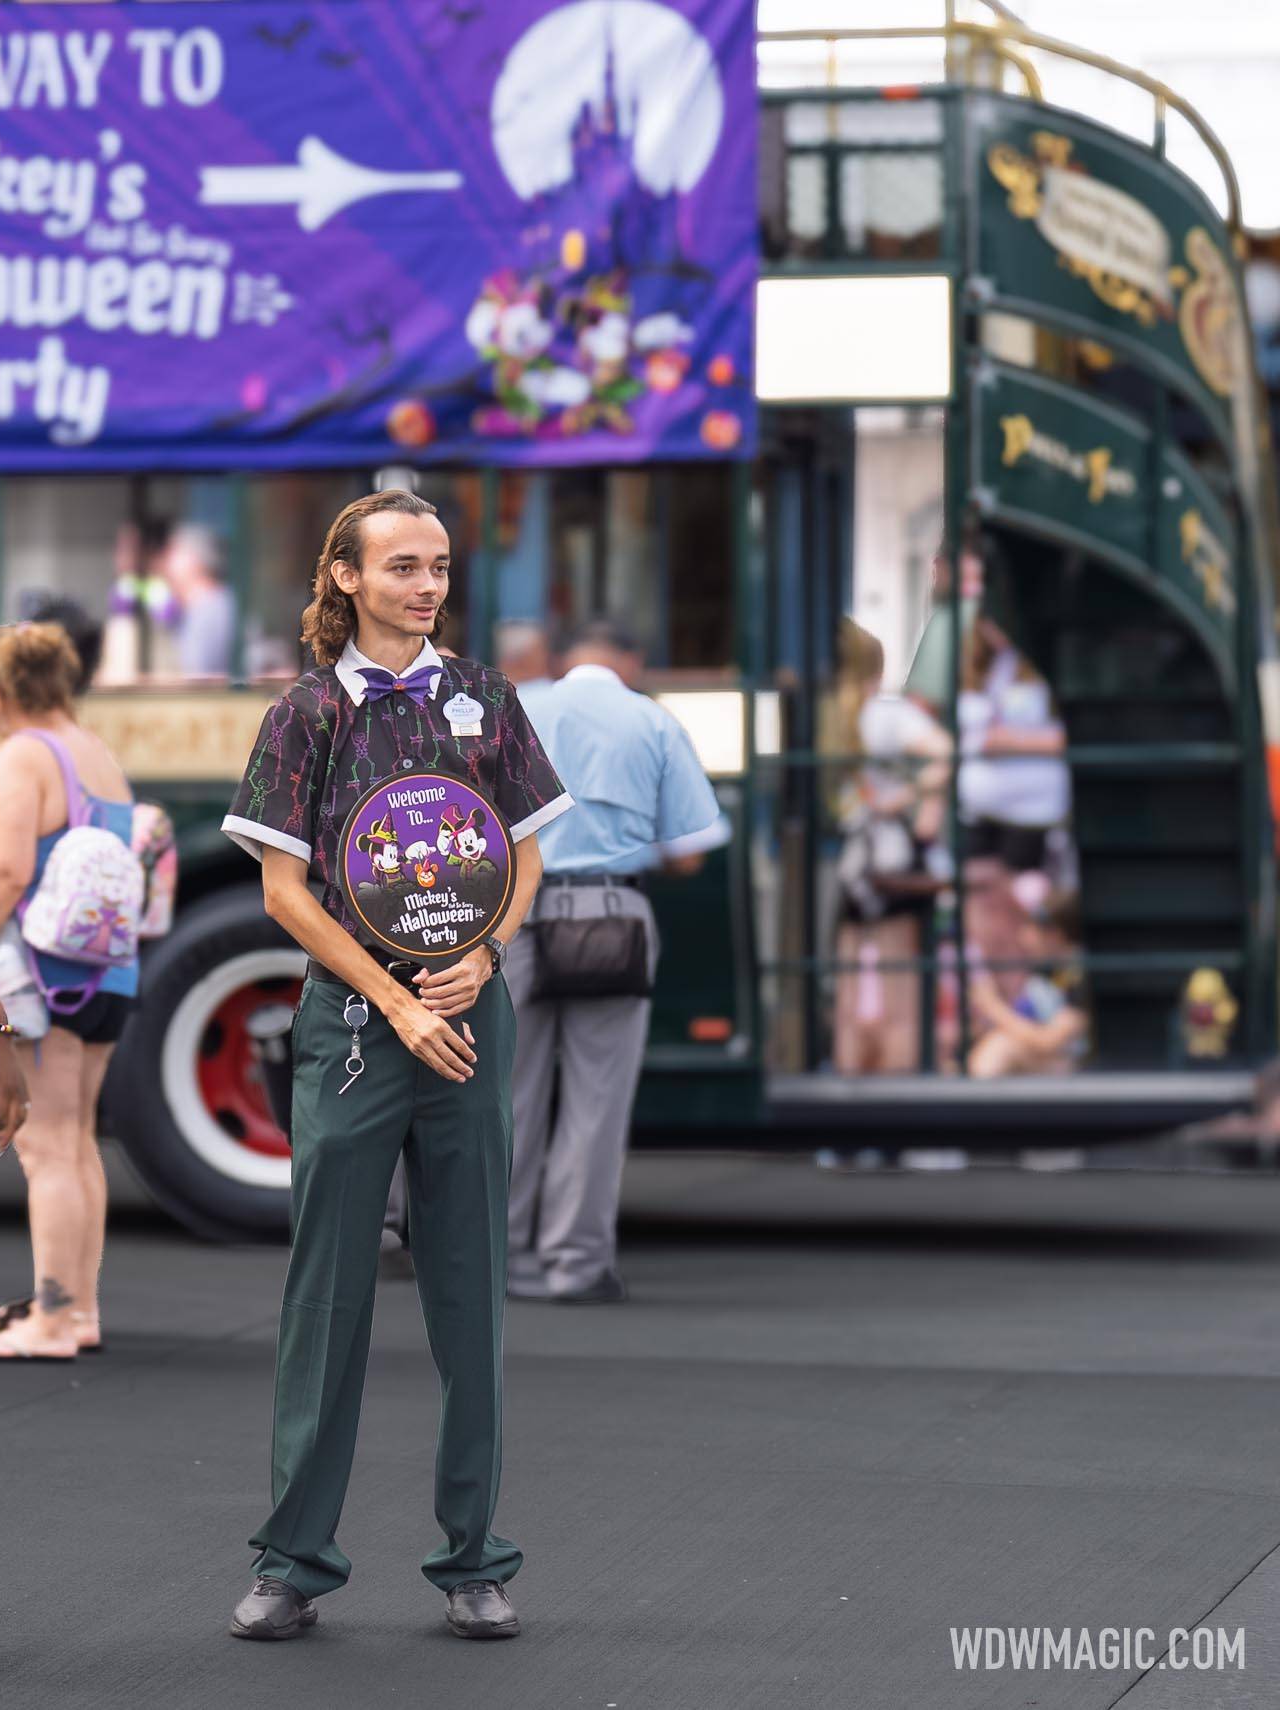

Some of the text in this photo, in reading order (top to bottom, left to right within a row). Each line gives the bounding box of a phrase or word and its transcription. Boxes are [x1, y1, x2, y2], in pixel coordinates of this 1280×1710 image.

[128, 27, 225, 109] TO
[387, 786, 446, 809] Welcome
[404, 886, 457, 911] Mickey's
[399, 907, 474, 934] Halloween
[422, 925, 458, 946] Party
